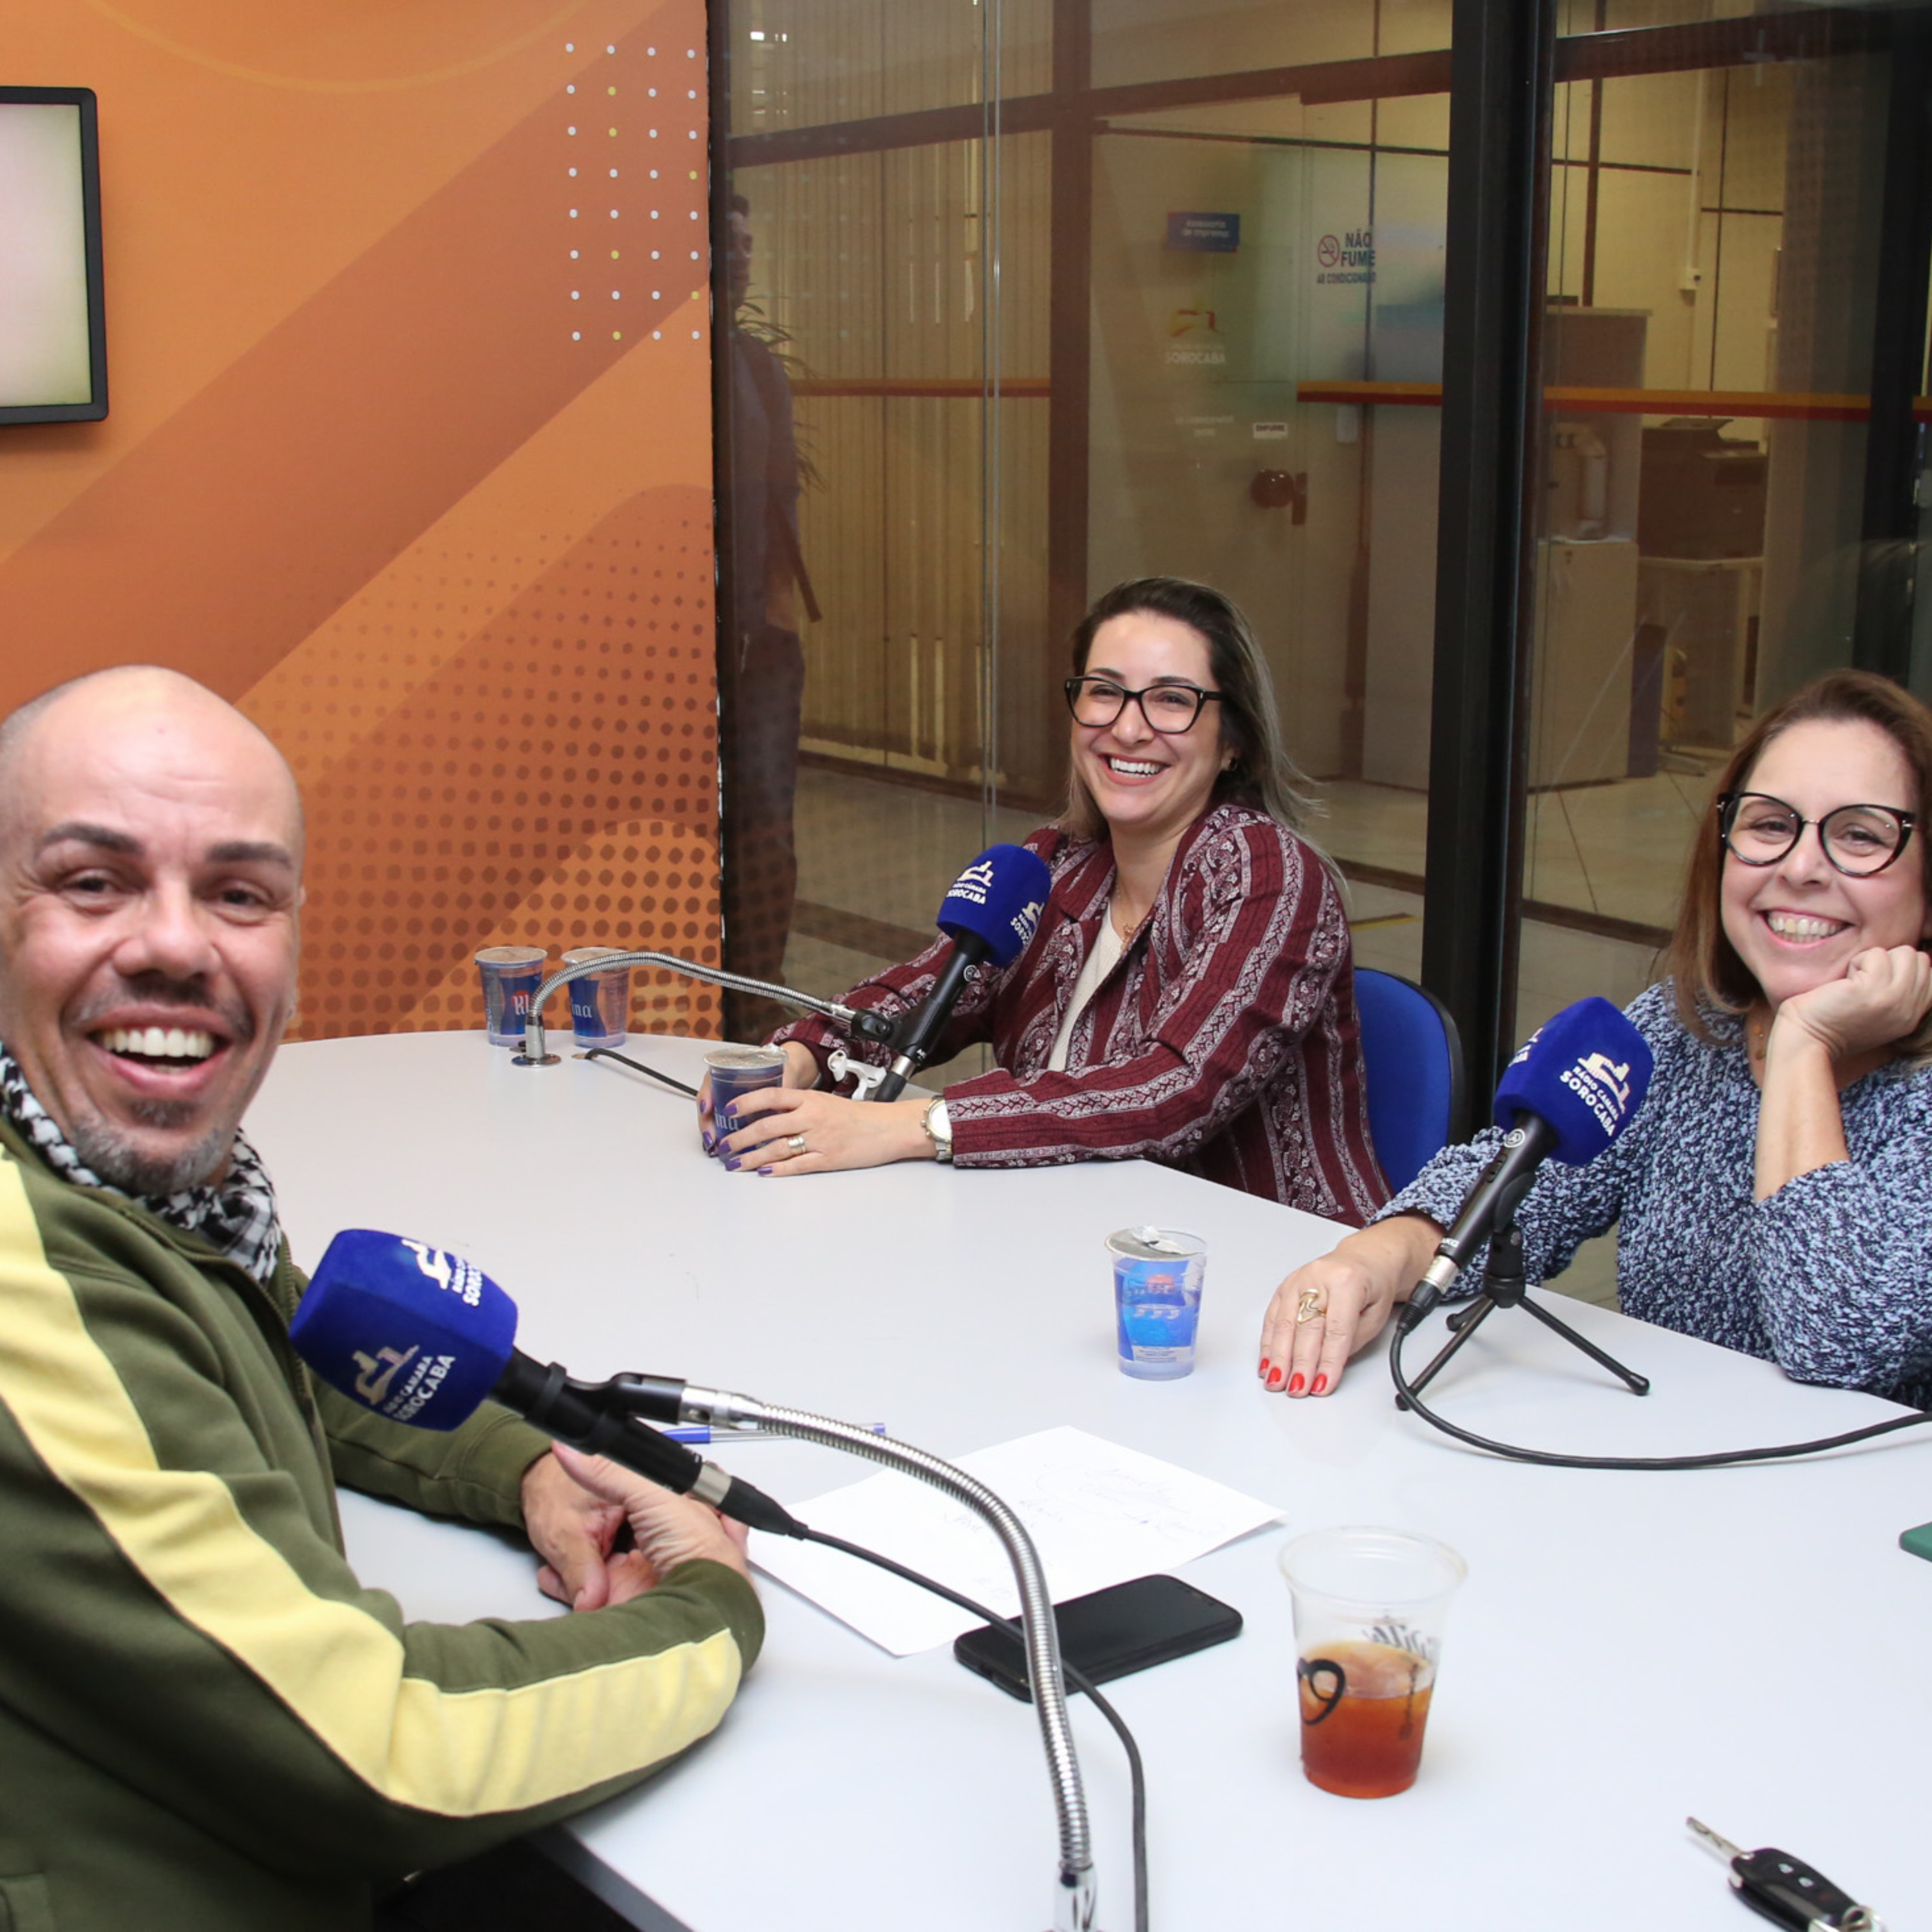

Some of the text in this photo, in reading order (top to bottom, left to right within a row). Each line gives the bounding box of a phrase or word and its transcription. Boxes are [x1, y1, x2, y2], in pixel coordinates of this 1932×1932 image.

[1345, 229, 1372, 248] NÃO
[1340, 250, 1376, 267] FUME
[1572, 1066, 1598, 1091] RÁDIO
[1559, 1070, 1616, 1137] SOROCABA
